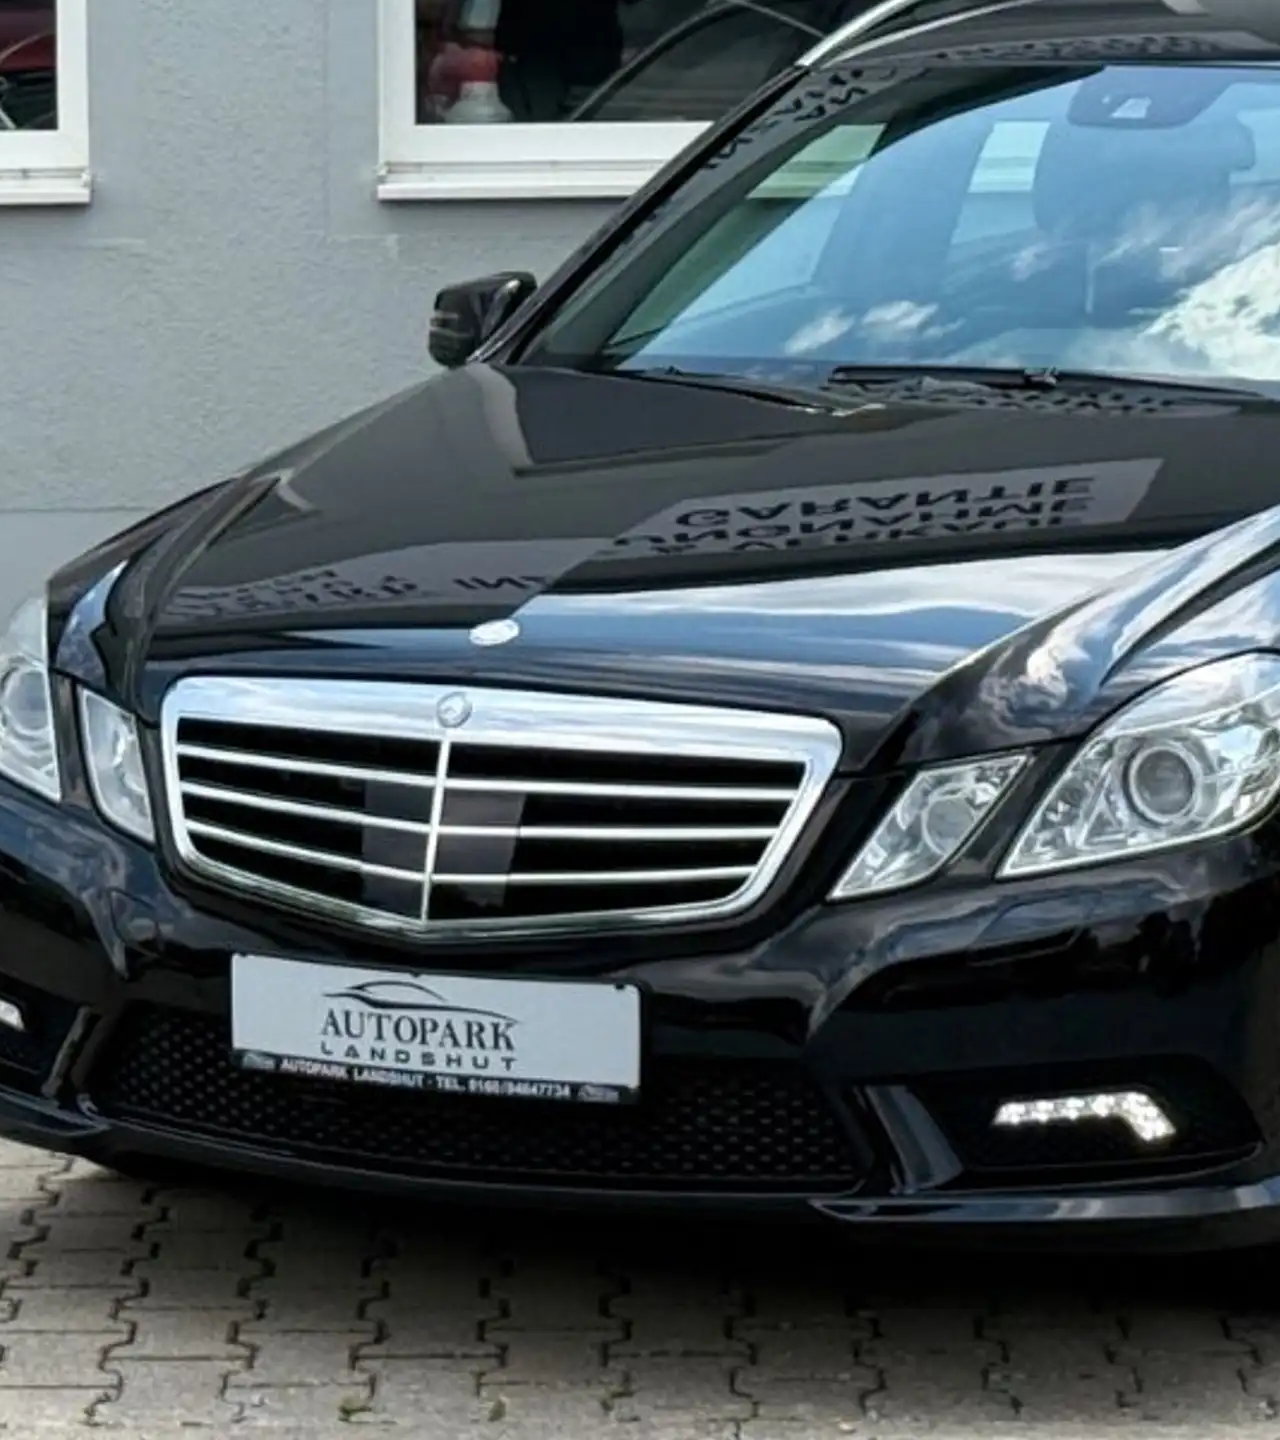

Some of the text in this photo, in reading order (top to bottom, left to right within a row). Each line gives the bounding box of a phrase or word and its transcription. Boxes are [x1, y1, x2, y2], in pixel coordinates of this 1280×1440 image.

[320, 1008, 516, 1051] AUTOPARK
[320, 1041, 517, 1071] LANDSHUT
[279, 1057, 347, 1080] AUTOPARK
[353, 1065, 425, 1089] LANDSHUT
